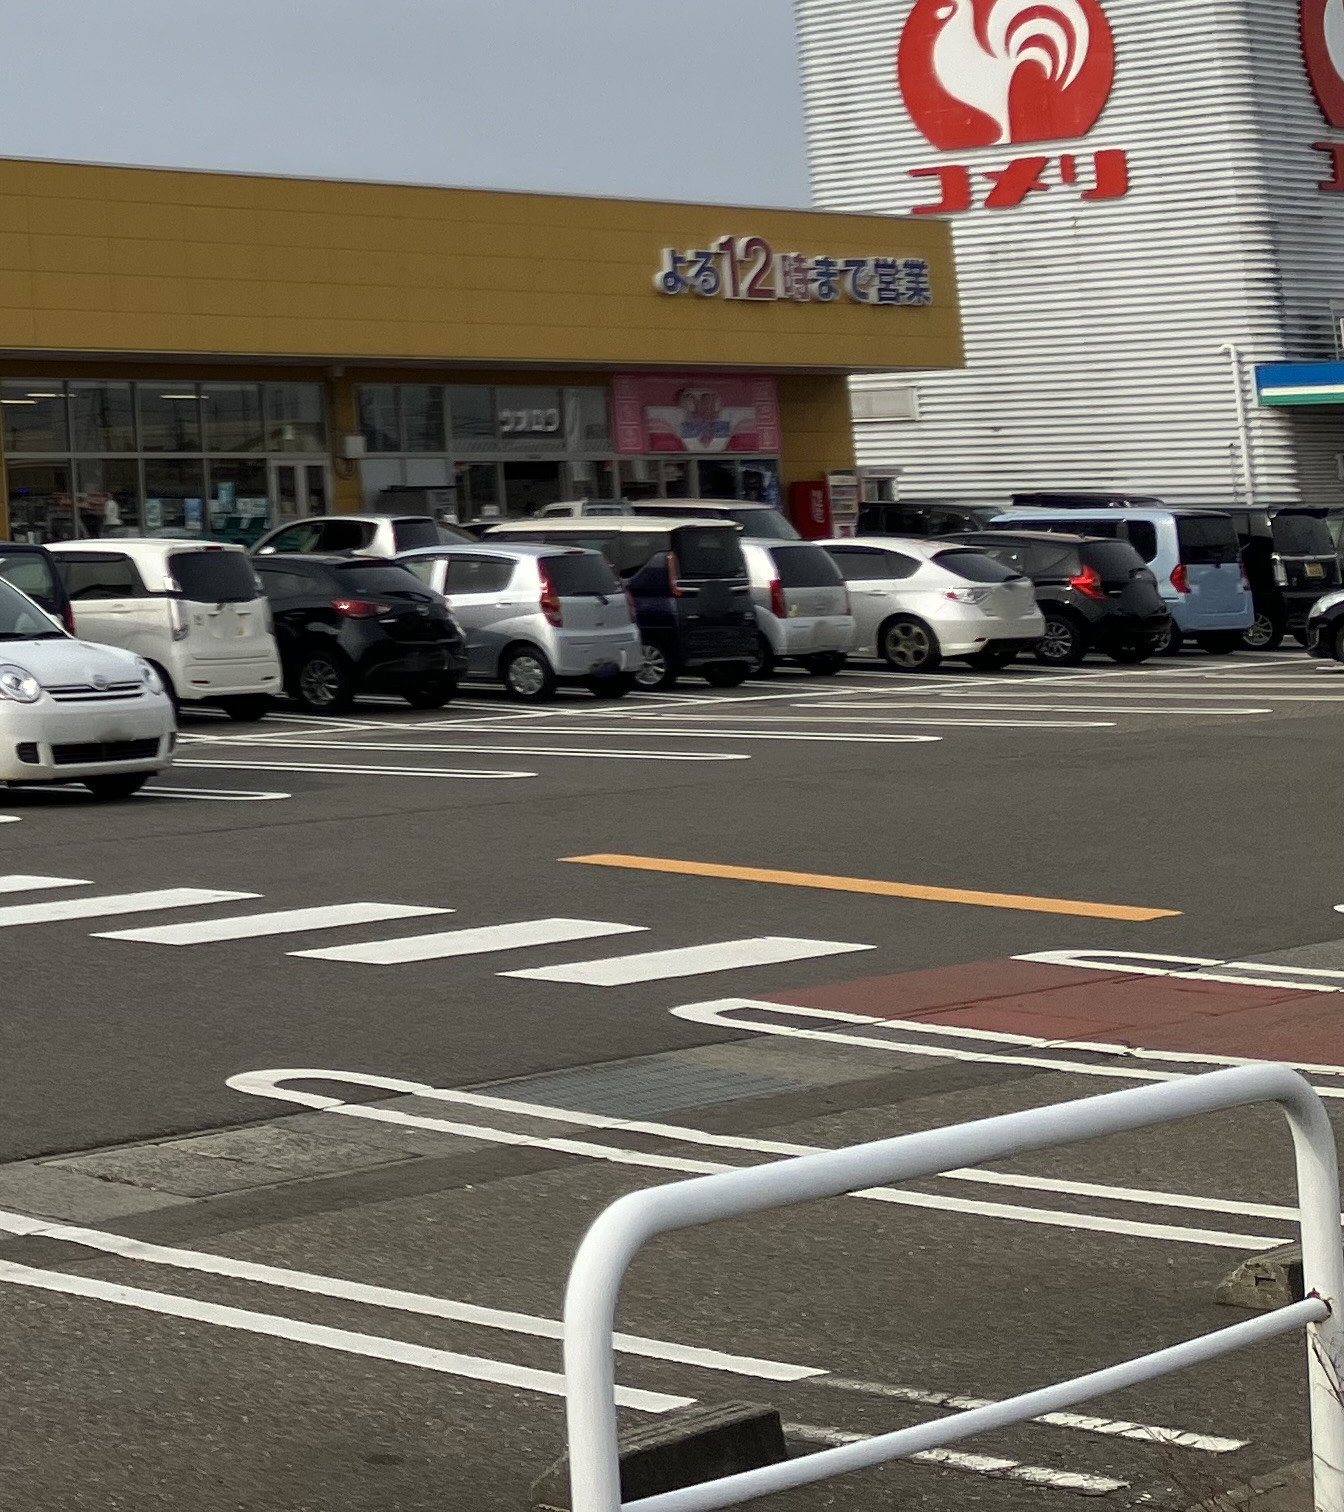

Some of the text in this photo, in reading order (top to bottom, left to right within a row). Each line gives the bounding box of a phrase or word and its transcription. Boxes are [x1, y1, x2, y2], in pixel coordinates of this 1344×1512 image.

[906, 148, 1129, 215] コメリ
[653, 235, 933, 305] よる12時まで営業
